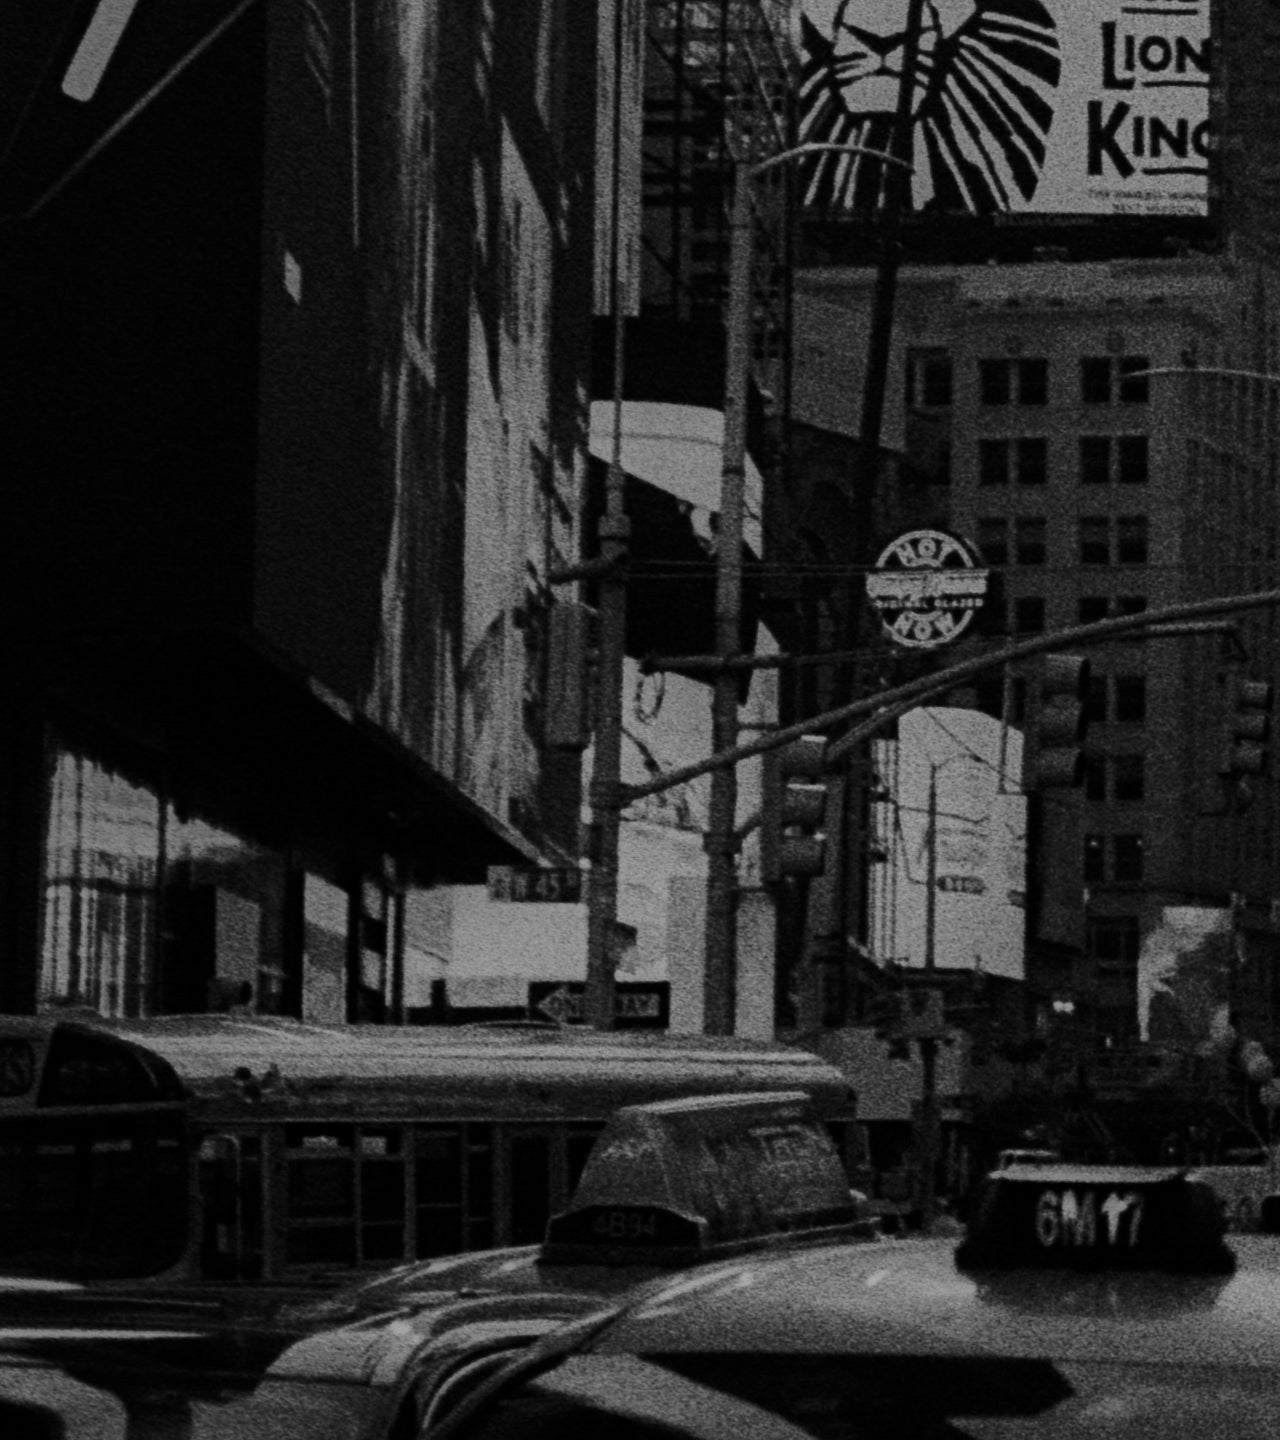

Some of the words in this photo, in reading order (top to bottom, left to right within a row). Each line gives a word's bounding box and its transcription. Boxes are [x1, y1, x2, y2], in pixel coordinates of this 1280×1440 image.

[894, 538, 957, 567] HOT
[892, 610, 955, 640] NOW
[591, 1211, 658, 1238] 4B94
